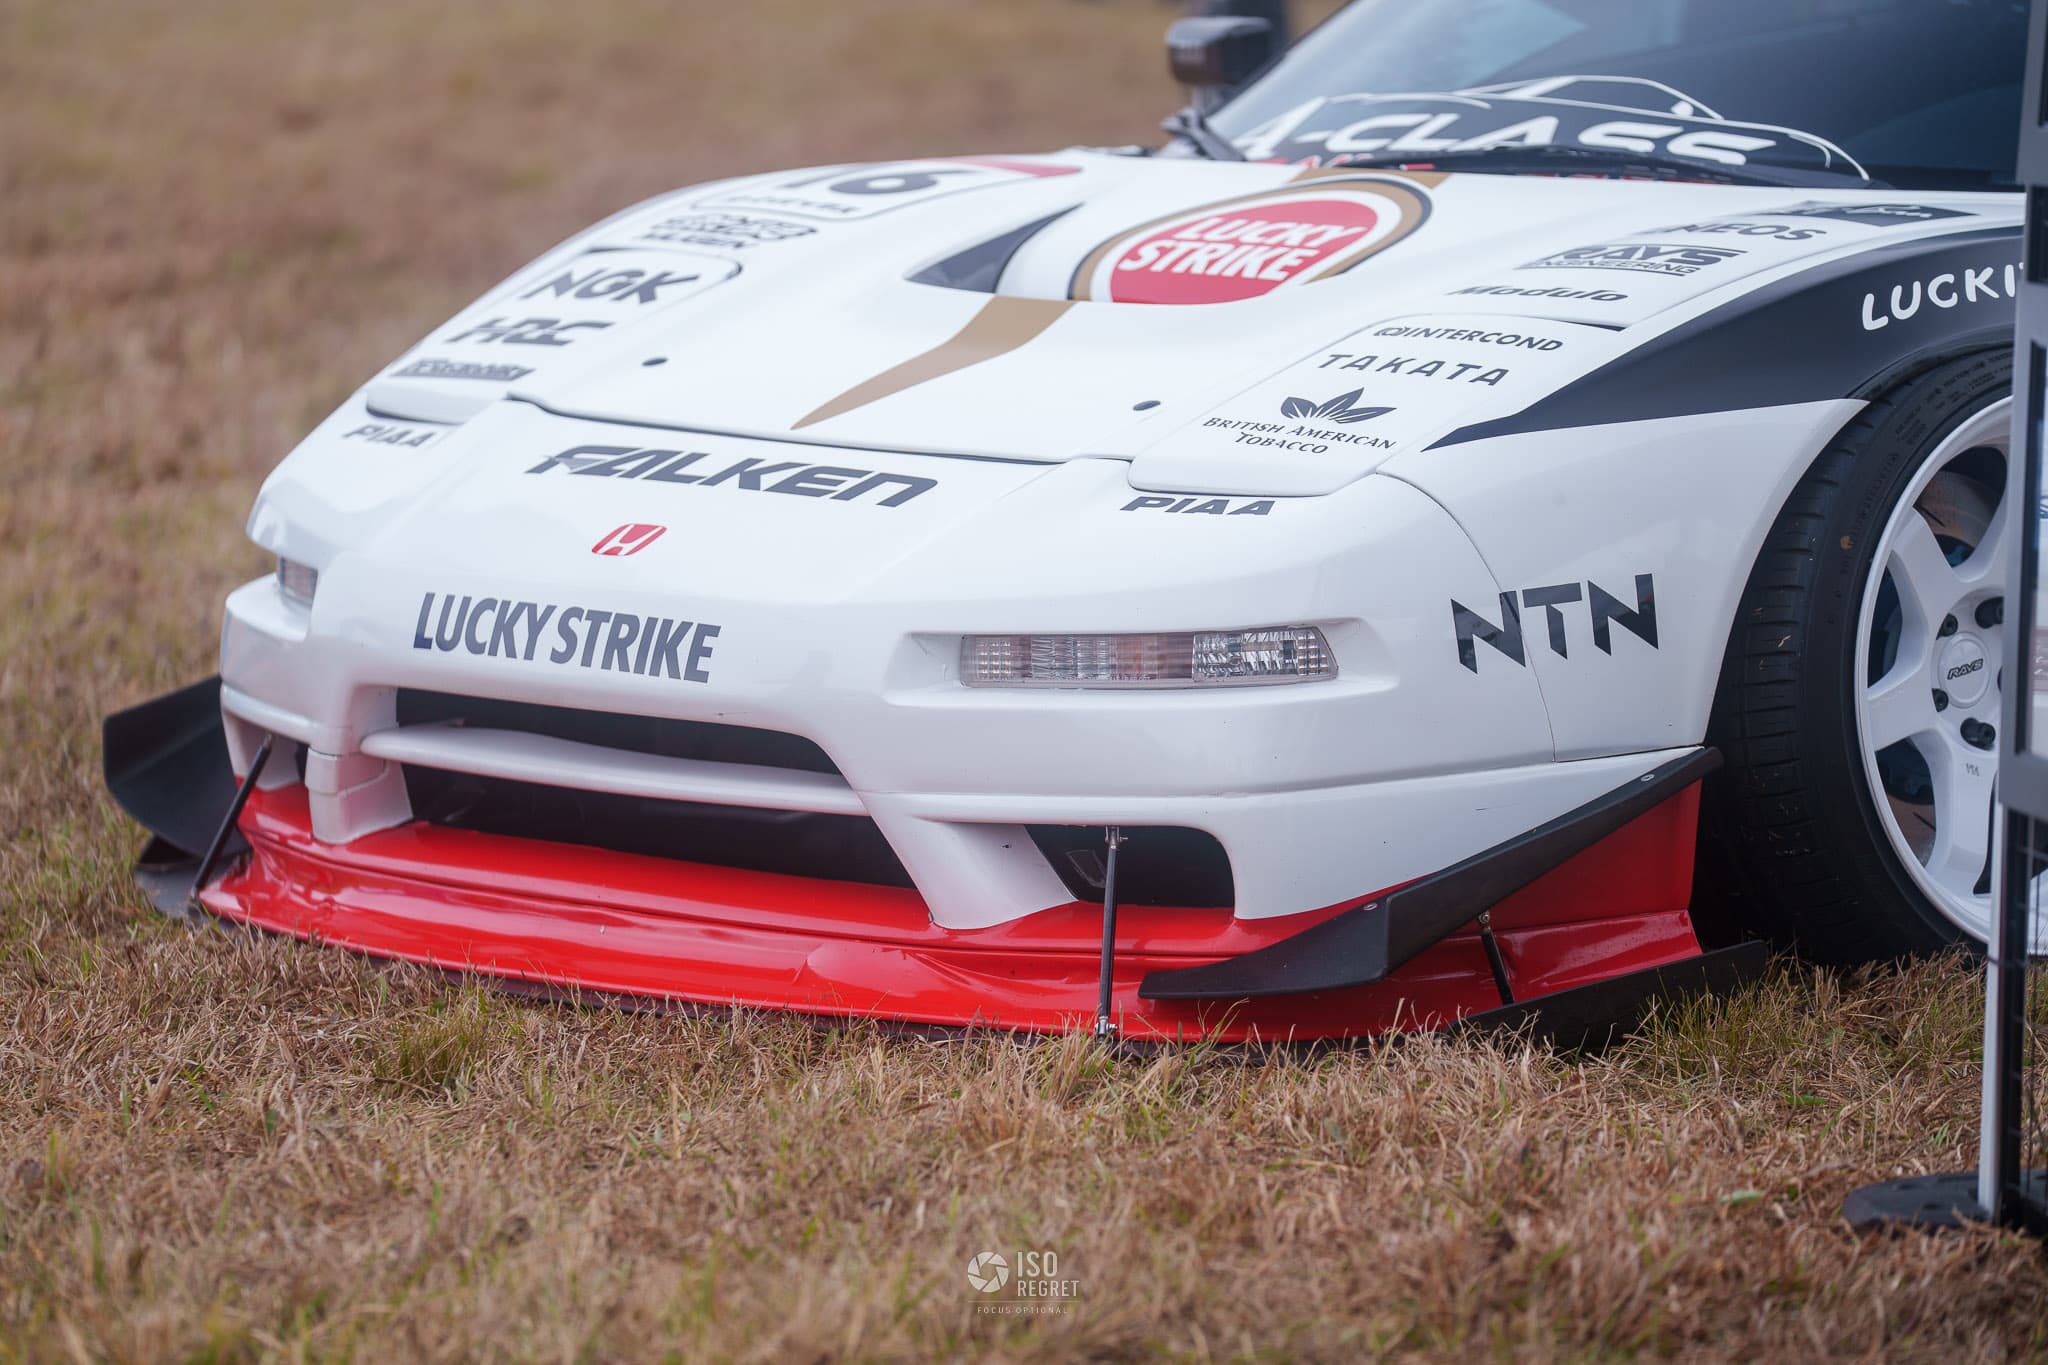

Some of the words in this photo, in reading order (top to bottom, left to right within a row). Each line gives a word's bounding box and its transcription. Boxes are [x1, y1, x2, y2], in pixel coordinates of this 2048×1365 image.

[1172, 216, 1369, 247] LUCKY
[1117, 240, 1320, 282] STRIKE
[1560, 246, 1738, 267] RAYS
[518, 268, 701, 304] NGK
[1444, 285, 1629, 301] Modulo
[1862, 262, 2024, 331] LUCKI
[440, 317, 617, 346] HRC
[1403, 326, 1563, 351] INTERCOND
[1317, 353, 1510, 386] TAKATA
[341, 424, 437, 448] PIAA
[1202, 417, 1286, 434] BRITISH
[1287, 425, 1397, 450] AMERICAN
[1234, 431, 1329, 454] TOBACCO
[525, 444, 938, 508] FALKEN
[1119, 496, 1276, 516] PIAA
[413, 592, 556, 662] LUCKY
[549, 606, 722, 684] STRIKE
[1450, 573, 1659, 675] NTN
[1947, 658, 1984, 680] RAYS
